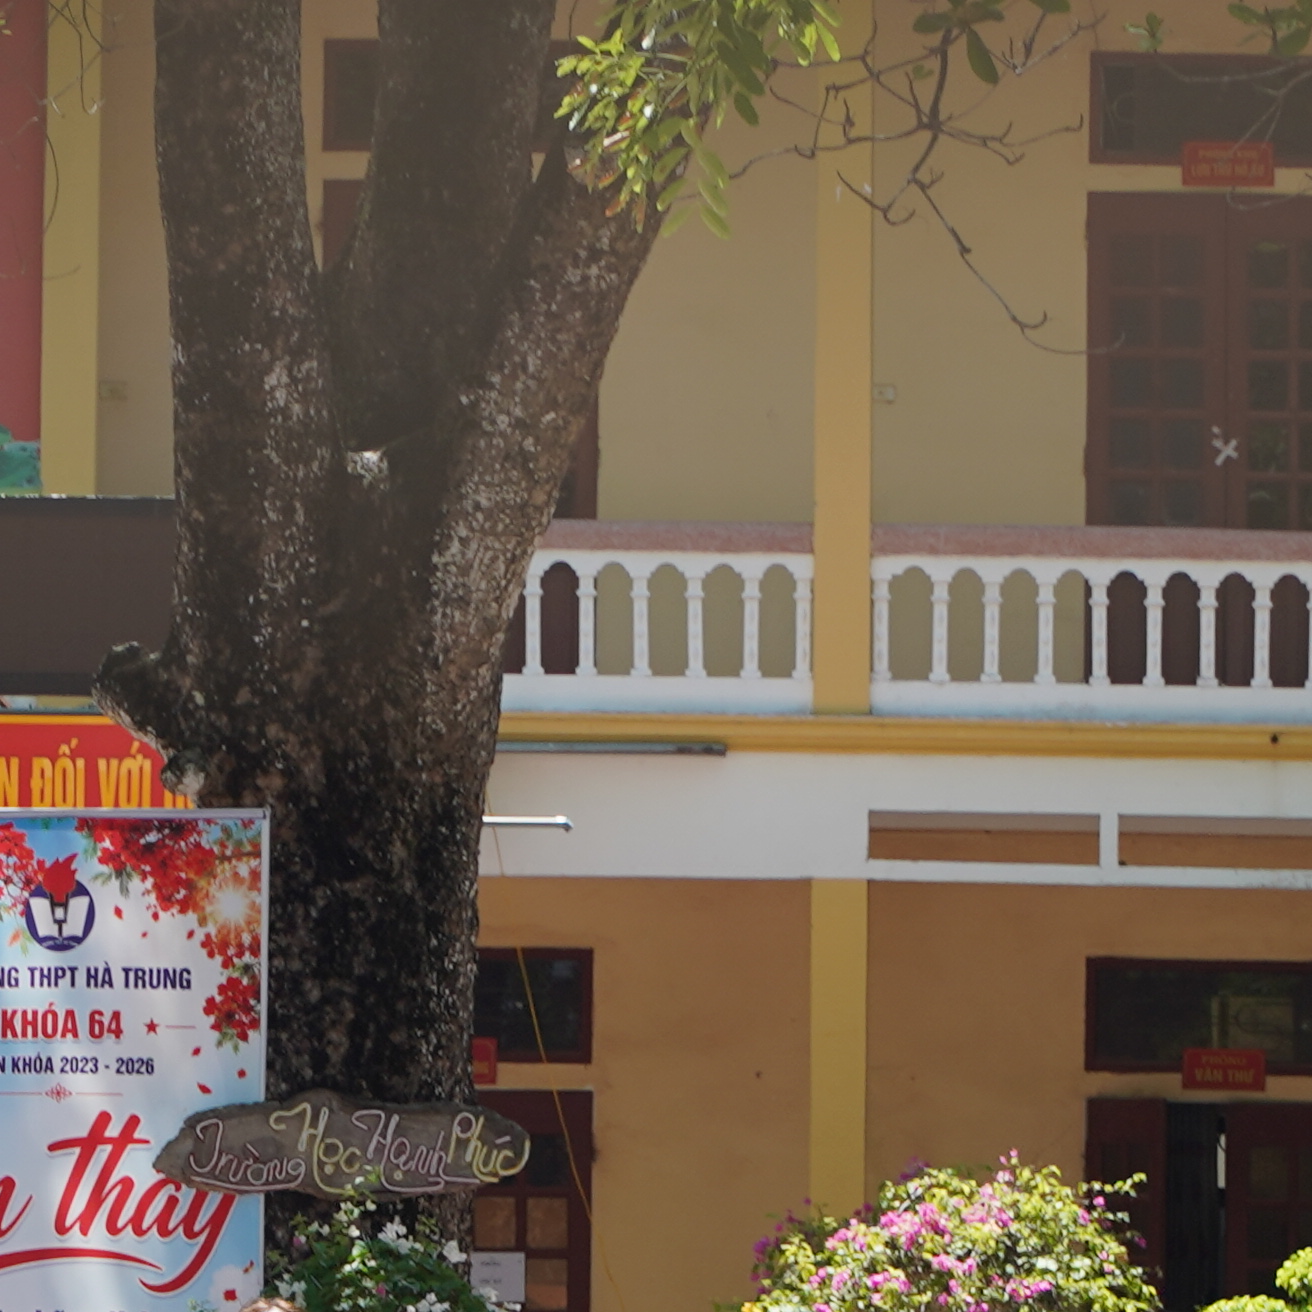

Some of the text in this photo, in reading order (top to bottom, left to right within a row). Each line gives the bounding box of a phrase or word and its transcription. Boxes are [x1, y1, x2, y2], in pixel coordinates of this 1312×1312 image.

[30, 737, 86, 808] ĐỐI
[97, 740, 152, 808] VỚI
[27, 965, 79, 989] THPT
[86, 960, 114, 989] HÀ
[121, 967, 193, 990] TRUNG
[0, 1001, 124, 1041] KHÓA 64
[11, 1051, 55, 1075] KHÓA
[60, 1056, 99, 1075] 2023
[115, 1056, 155, 1076] 2026
[190, 1101, 531, 1195] Trường Học Hạnh Phúc
